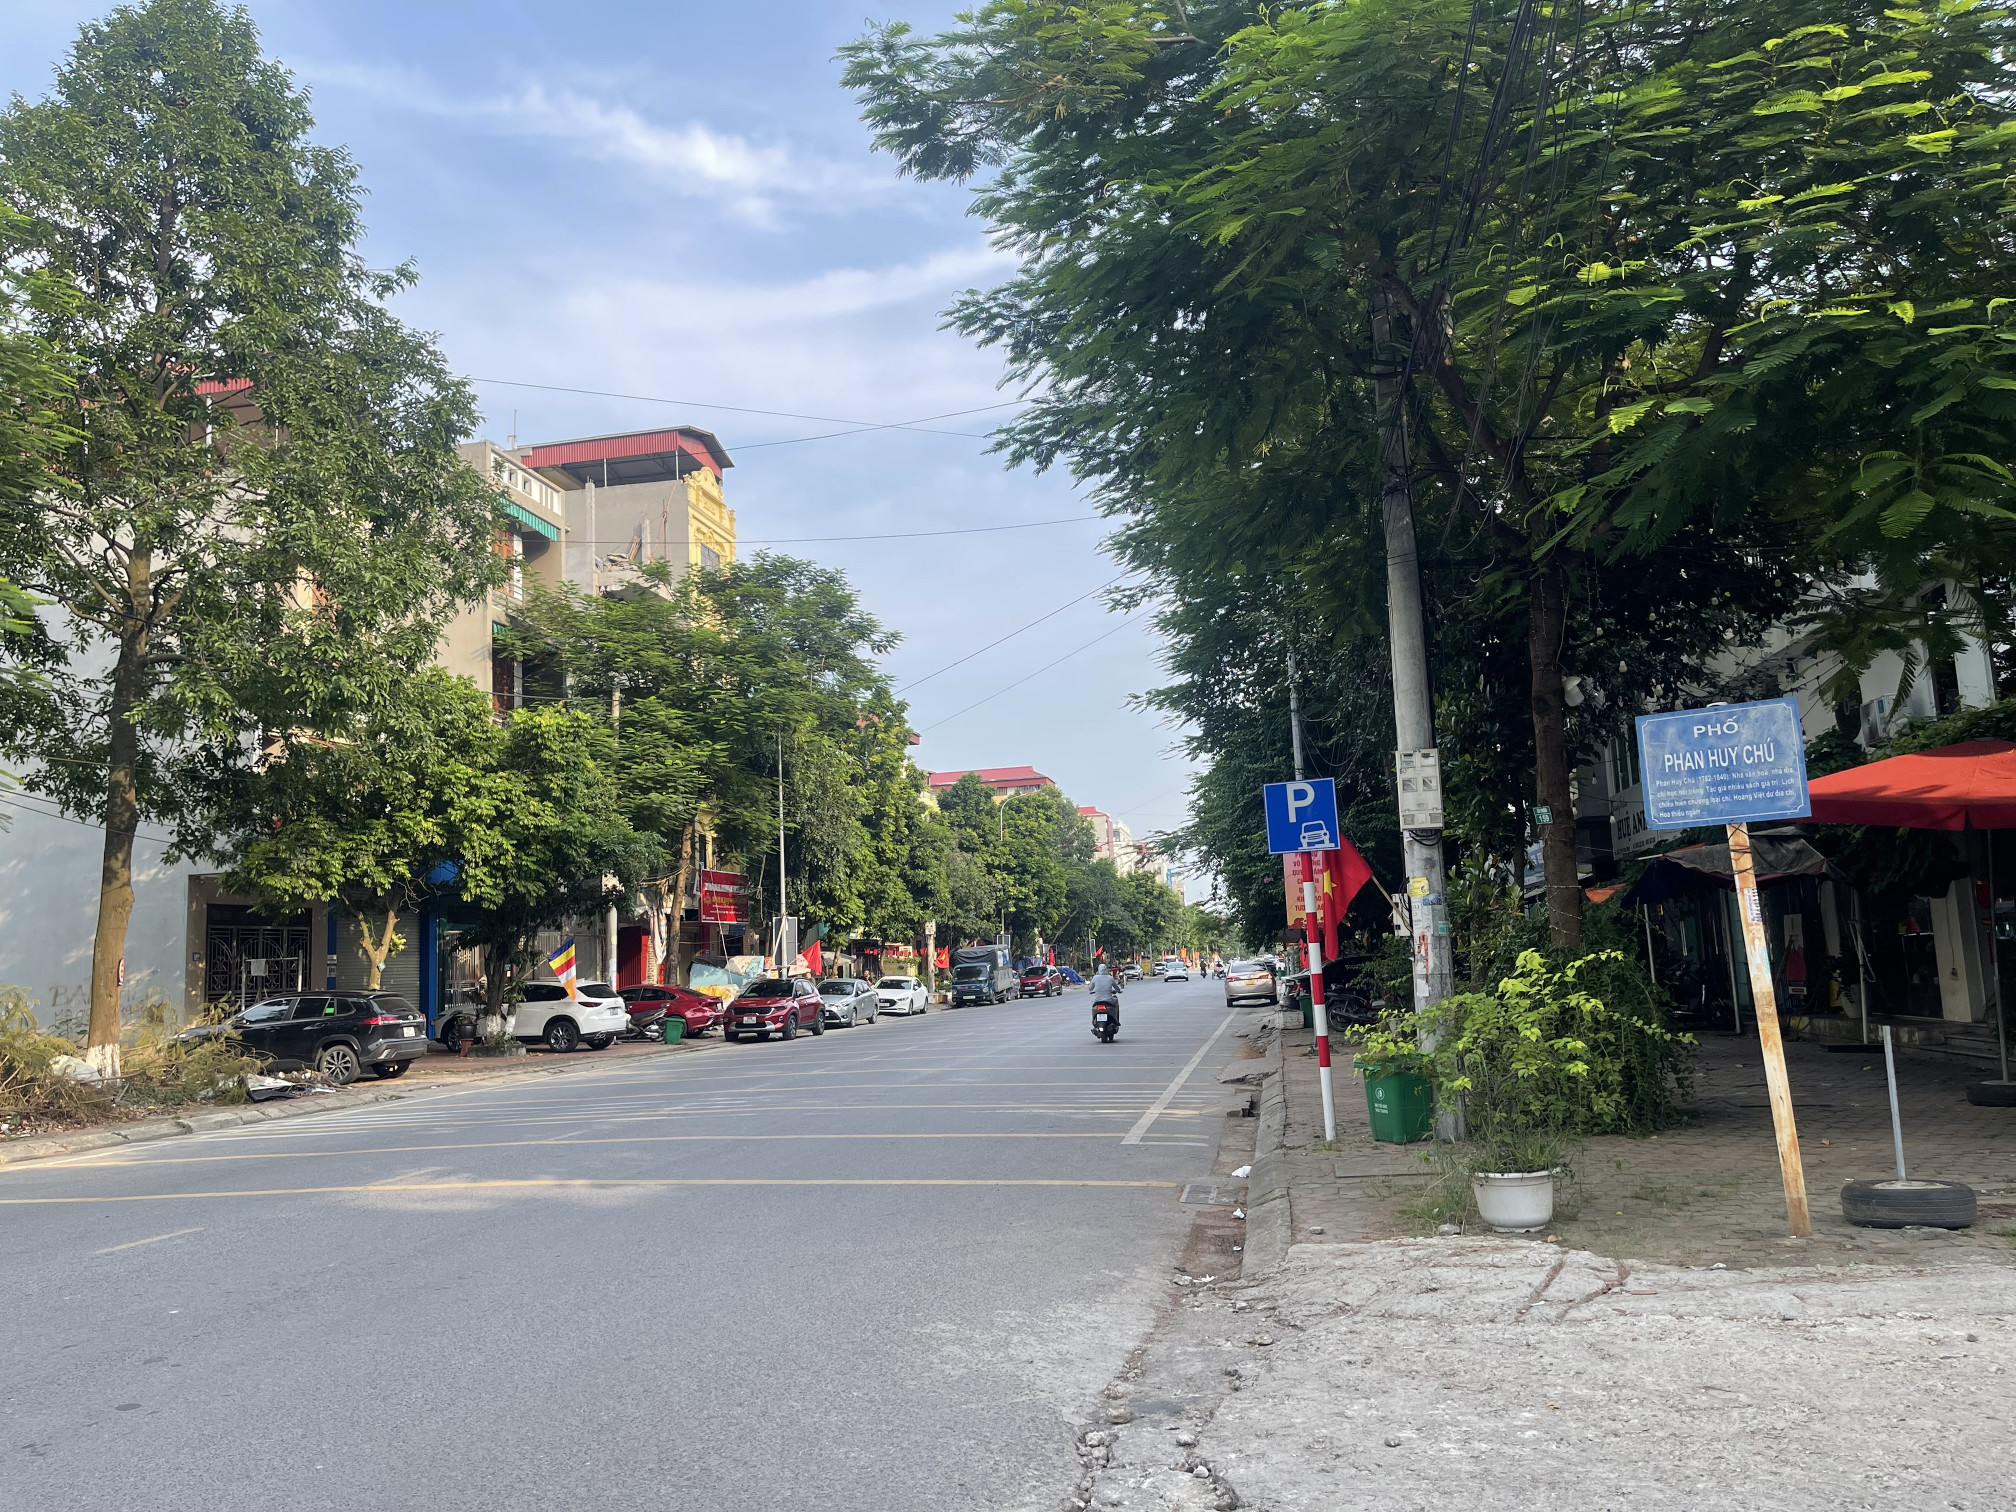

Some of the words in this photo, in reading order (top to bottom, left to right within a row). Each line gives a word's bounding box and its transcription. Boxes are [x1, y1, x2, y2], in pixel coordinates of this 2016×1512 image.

[1693, 715, 1738, 738] PHỐ
[1664, 750, 1705, 773] PHAN
[1708, 746, 1738, 768] HUY
[1743, 737, 1775, 764] CHÚ
[1286, 782, 1315, 823] P
